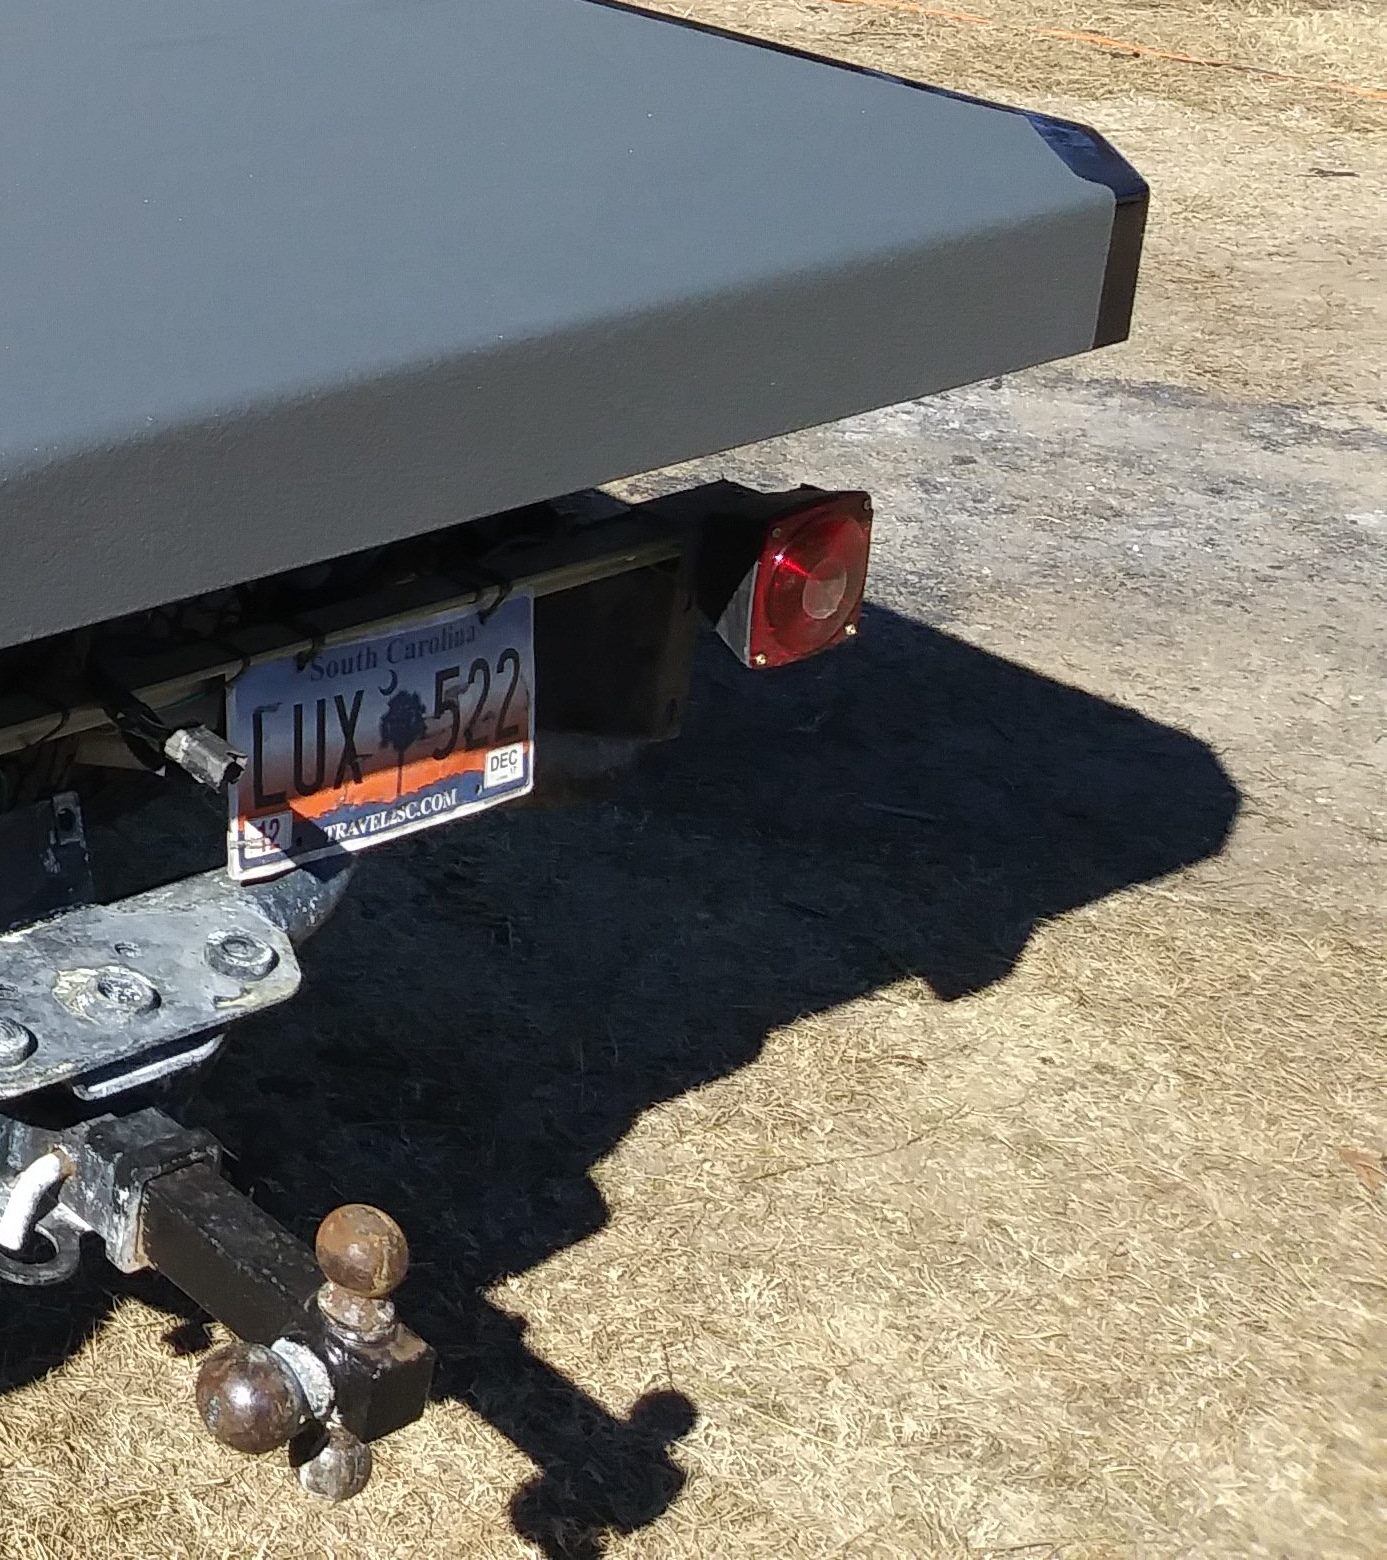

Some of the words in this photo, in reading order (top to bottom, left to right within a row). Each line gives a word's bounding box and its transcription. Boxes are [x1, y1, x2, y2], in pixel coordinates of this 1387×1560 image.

[310, 647, 377, 682] South
[386, 623, 475, 666] Carolina
[434, 647, 520, 760] 522
[491, 749, 518, 772] DEC
